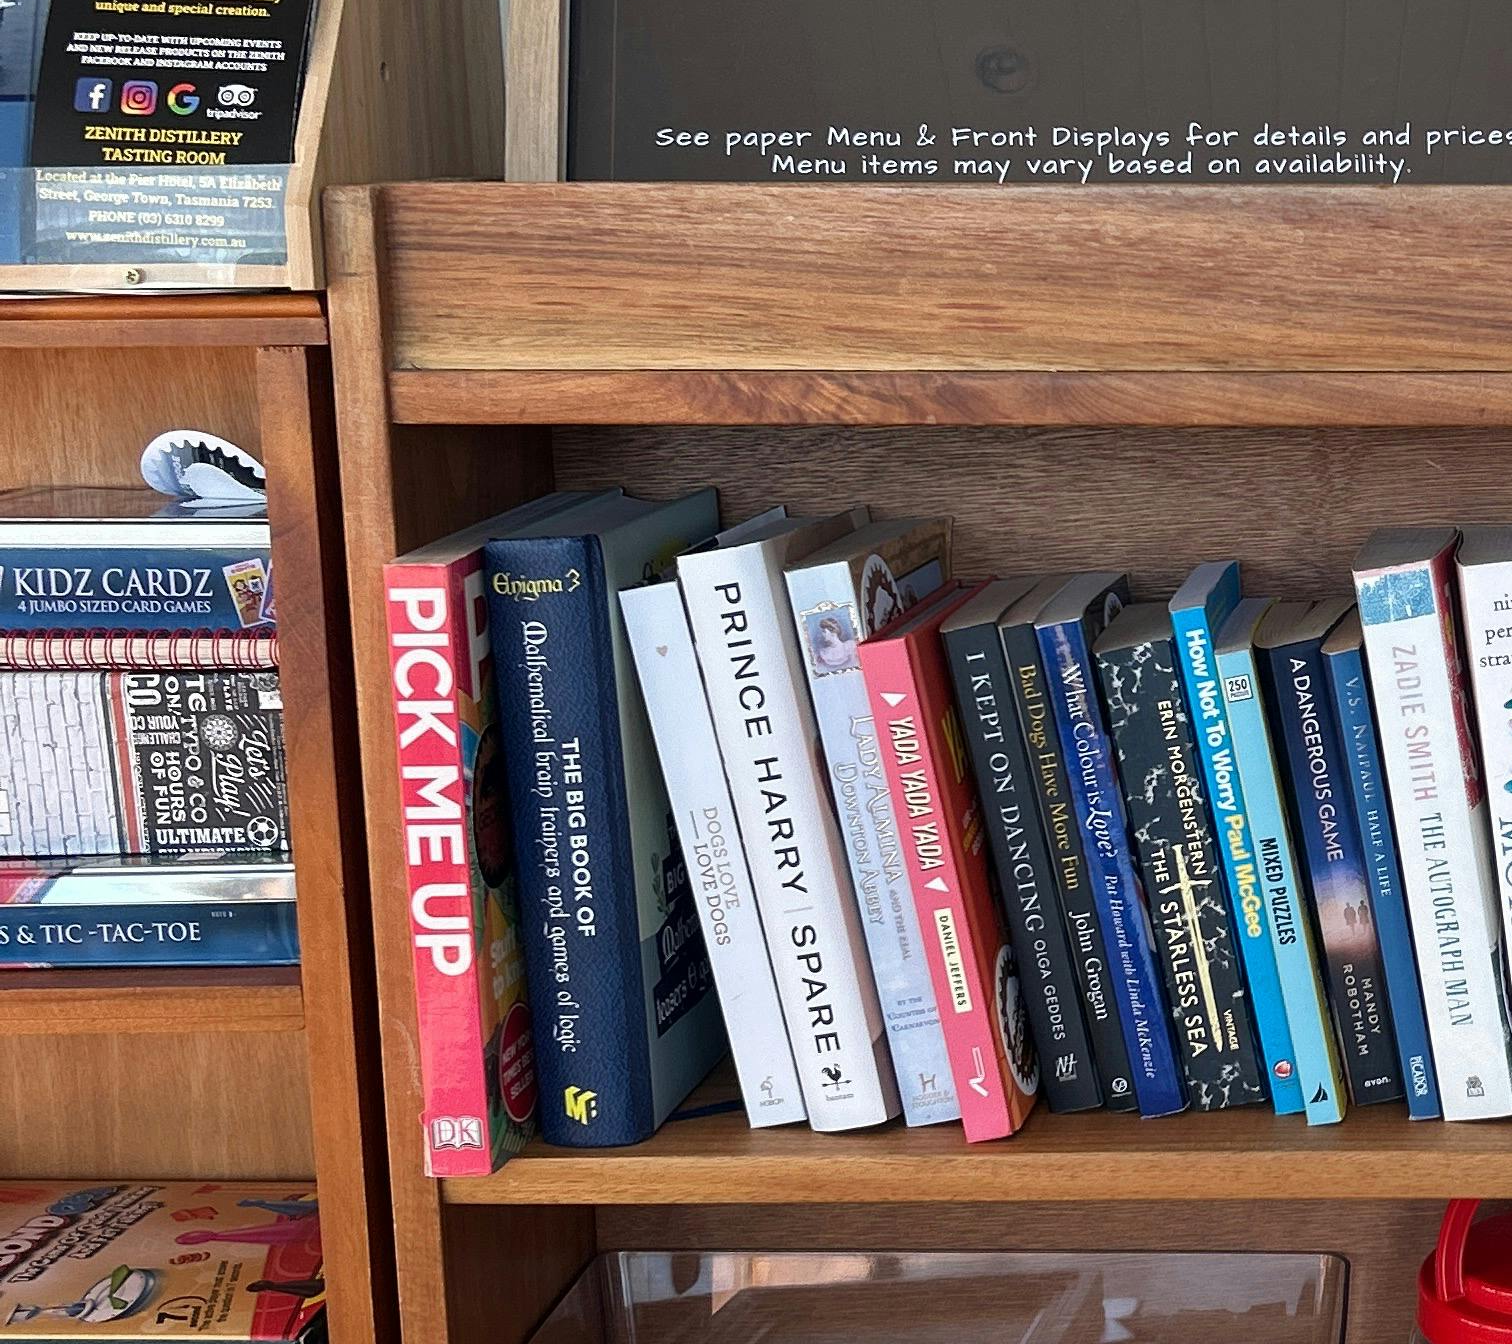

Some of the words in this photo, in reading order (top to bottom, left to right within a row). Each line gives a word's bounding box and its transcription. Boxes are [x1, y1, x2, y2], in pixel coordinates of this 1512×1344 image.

[85, 126, 147, 142] ZENITH
[149, 128, 243, 146] DISTILLERY
[102, 147, 172, 164] TASTING
[176, 150, 225, 165] ROOM
[656, 129, 709, 145] See
[727, 131, 811, 152] paper
[828, 127, 900, 145] Menu
[917, 124, 935, 145] &
[952, 127, 1037, 146] Front
[1053, 127, 1169, 153] Displays
[1186, 123, 1238, 145] for
[1254, 123, 1346, 146] details
[1363, 123, 1409, 145] and
[13, 568, 95, 597] KIDZ
[102, 568, 214, 597] CARDZ
[18, 601, 27, 613] 4
[29, 600, 78, 616] JUMBO
[79, 600, 120, 613] SIZED
[121, 600, 163, 613] CARD
[163, 601, 212, 614] GAMES
[389, 588, 457, 749] PICK
[966, 652, 985, 663] I
[1185, 628, 1209, 677] How
[1290, 658, 1306, 673] A
[1019, 664, 1042, 700] Bad
[1197, 680, 1218, 720] Not
[1392, 644, 1426, 717] ZADIE
[970, 673, 1005, 743] KEPT
[1027, 704, 1048, 749] Dogs
[888, 716, 922, 765] YADA
[1205, 721, 1227, 747] To
[1293, 675, 1332, 801] DANGEROUS
[561, 737, 583, 784] THE
[989, 752, 1015, 793] ON
[1039, 752, 1059, 797] Have
[1211, 749, 1236, 811] Worry
[1405, 725, 1438, 802] SMITH
[402, 765, 466, 865] ME
[566, 790, 587, 828] BIG
[714, 582, 773, 738] PRINCE
[753, 756, 808, 894] HARRY
[792, 925, 841, 1053] SPARE
[901, 770, 934, 818] YADA
[155, 827, 246, 845] ULTIMATE
[912, 822, 945, 871] YADA
[1050, 803, 1070, 850] More
[1224, 813, 1250, 862] Paul
[1318, 804, 1344, 863] GAME
[1420, 812, 1446, 851] THE
[569, 835, 593, 901] BOOK
[1000, 805, 1045, 932] DANCING
[1061, 855, 1080, 891] Fun
[1260, 838, 1284, 882] MIXED
[576, 910, 596, 937] OF
[1234, 863, 1262, 938] McGee
[1269, 886, 1296, 946] PUZZLES
[1426, 857, 1465, 973] AUTOGRAPH
[411, 883, 472, 976] UP
[1151, 848, 1169, 882] THE
[1160, 901, 1198, 1007] STARLESS
[1185, 1014, 1207, 1057] SEA
[1444, 980, 1474, 1026] MAN
